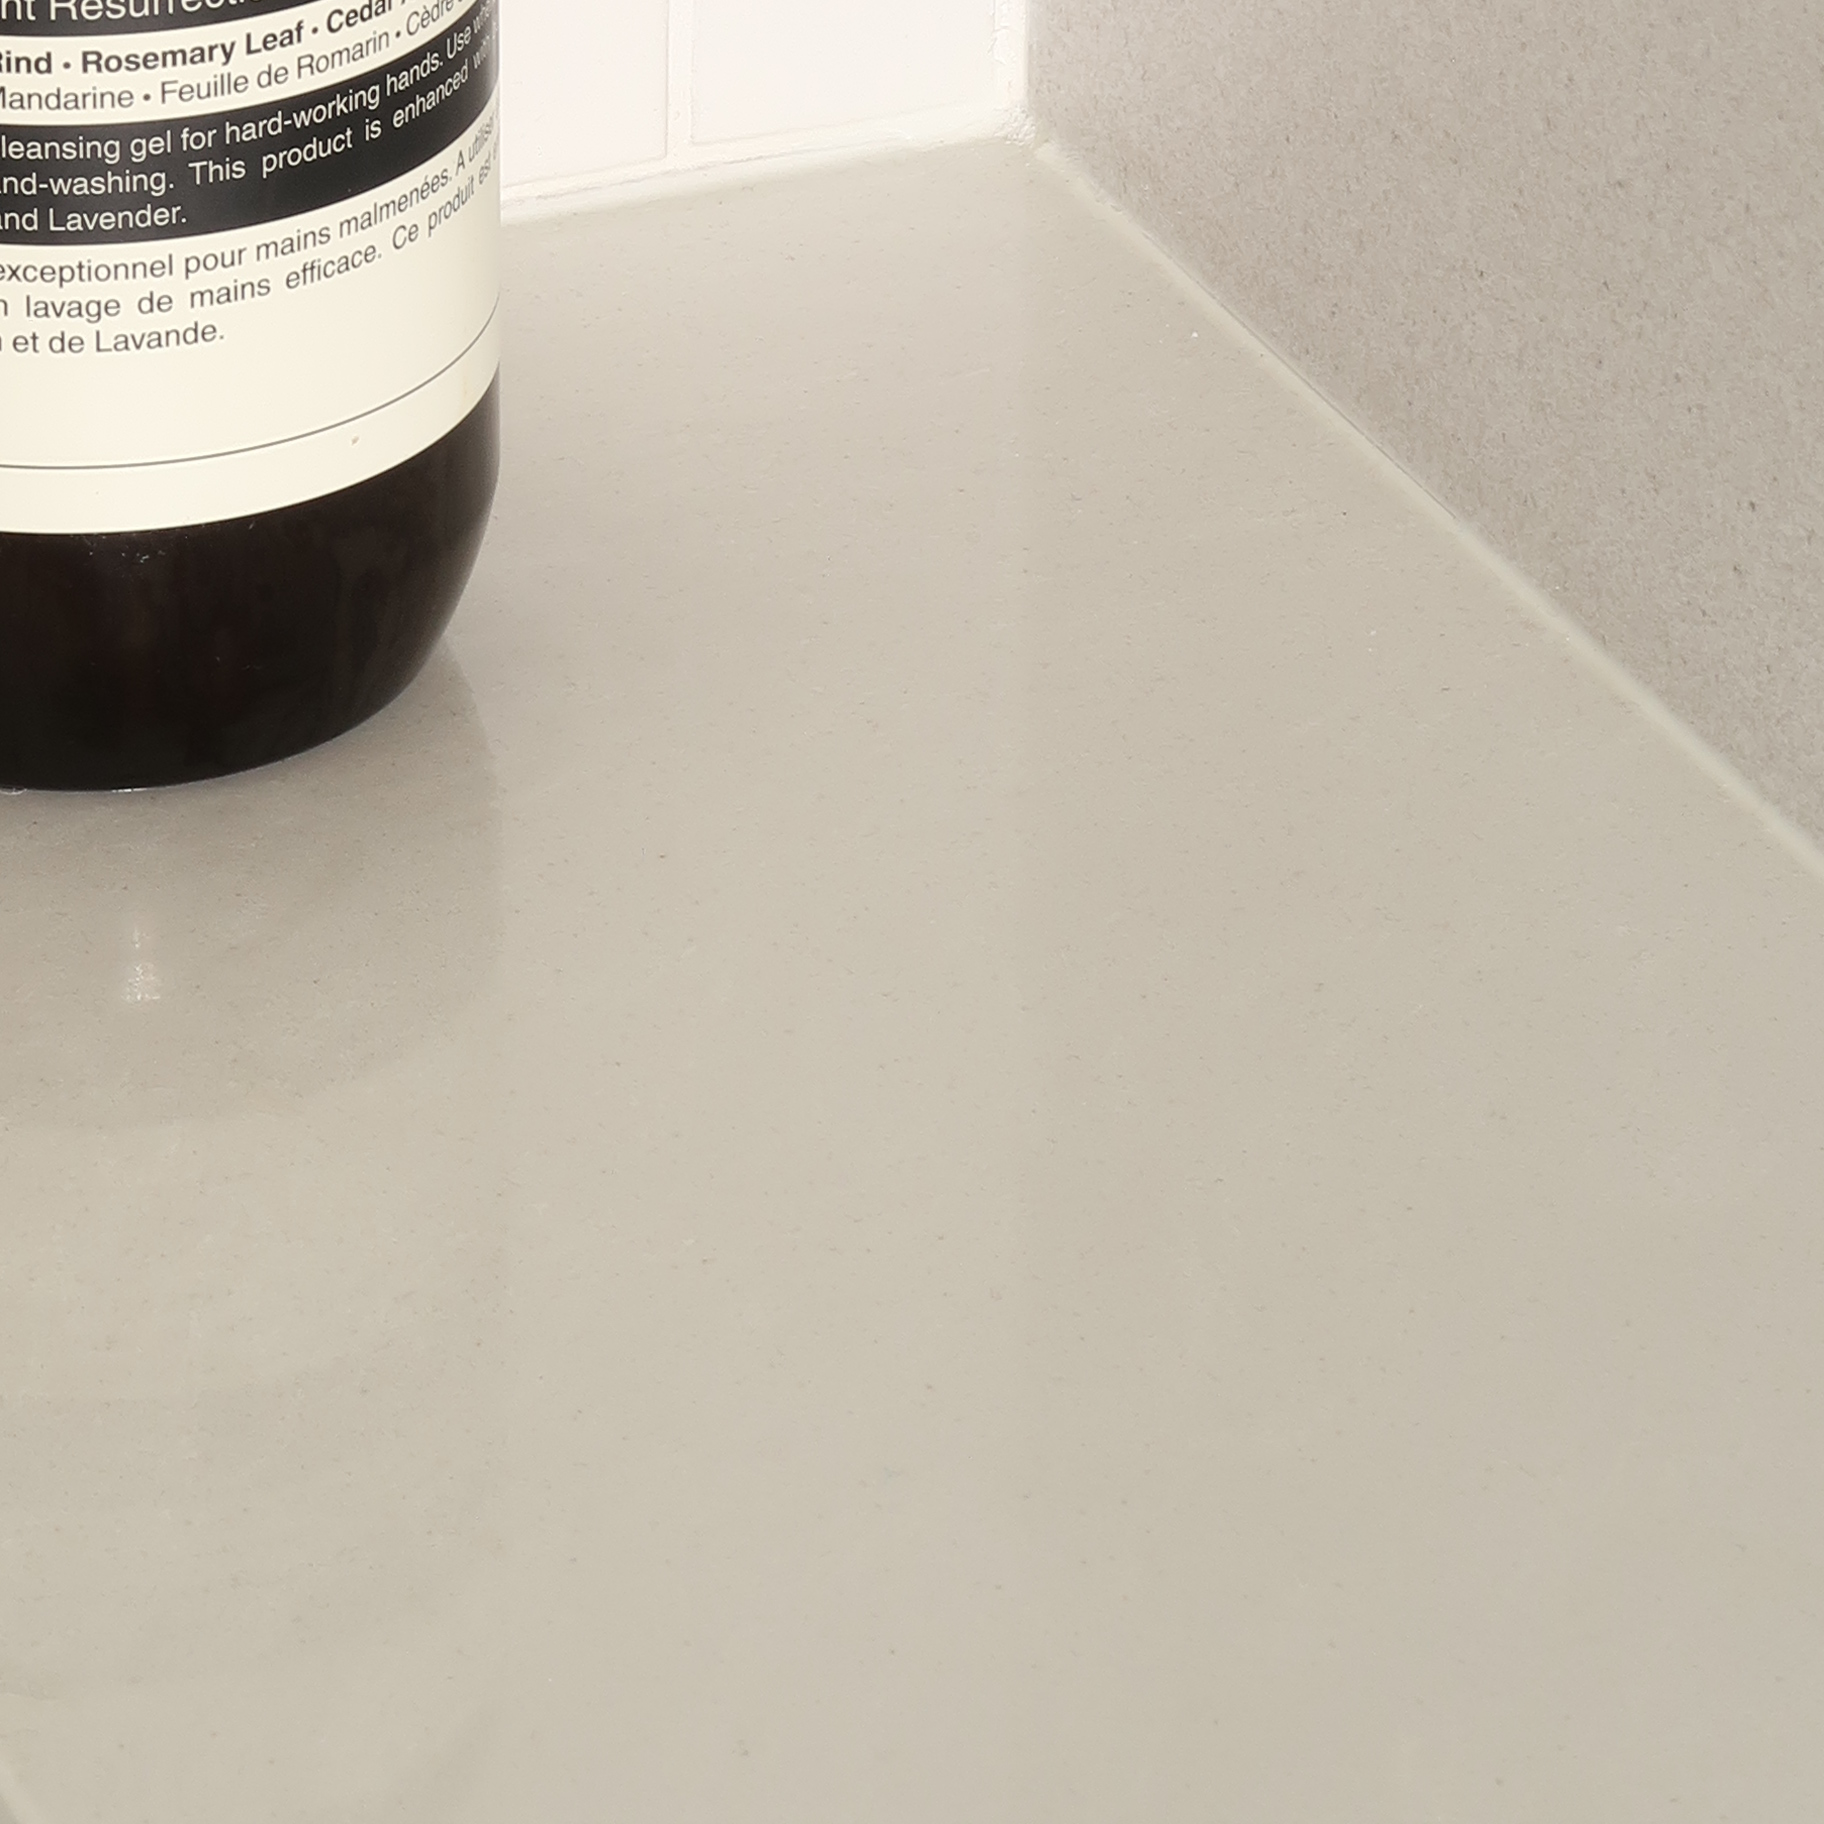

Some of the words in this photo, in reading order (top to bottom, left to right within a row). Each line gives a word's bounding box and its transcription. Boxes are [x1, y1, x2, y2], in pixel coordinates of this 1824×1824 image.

[81, 40, 236, 74] Rosemary
[246, 20, 305, 55] Leaf
[130, 130, 171, 163] gel
[181, 127, 217, 152] for
[225, 83, 381, 145] hard-working
[386, 50, 444, 97] hands.
[447, 26, 471, 60] Use
[161, 70, 250, 104] Feuille
[257, 63, 290, 89] de
[297, 29, 390, 80] Romarin
[188, 157, 246, 186] This
[262, 127, 353, 179] product
[364, 118, 382, 142] is
[392, 58, 469, 129] enhanced
[26, 294, 121, 324] lavage
[138, 290, 173, 316] de
[190, 277, 271, 309] mains
[285, 245, 383, 290] efficace.
[392, 223, 419, 250] Ce
[427, 174, 475, 239] produit
[49, 202, 187, 233] Lavender.
[185, 246, 248, 280] pour
[256, 225, 331, 262] mains
[339, 167, 453, 240] malmenées.
[456, 149, 466, 177] A
[12, 331, 40, 354] et
[48, 331, 85, 354] de
[95, 320, 225, 353] Lavande.
